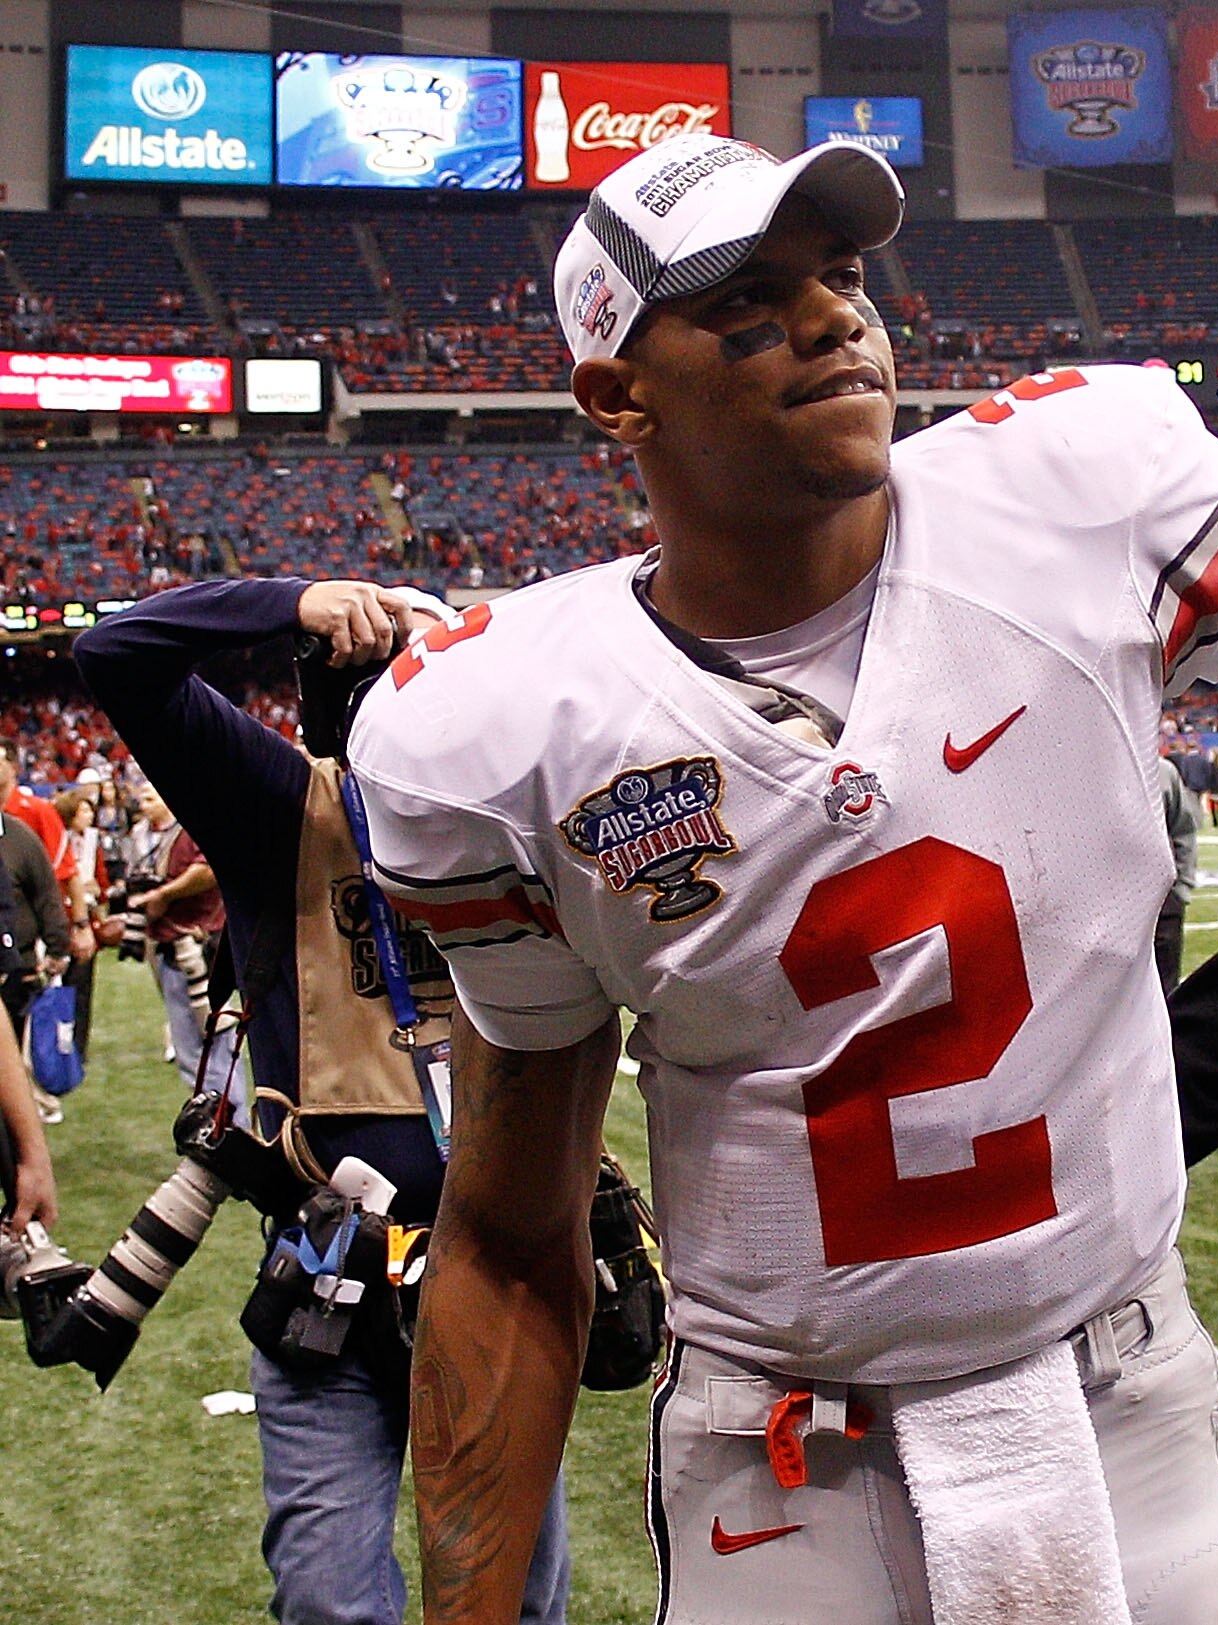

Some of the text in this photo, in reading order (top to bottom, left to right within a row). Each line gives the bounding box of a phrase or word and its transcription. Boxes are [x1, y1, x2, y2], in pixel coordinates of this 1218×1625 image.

[1051, 62, 1125, 80] Allstate
[635, 161, 679, 202] Allstate
[641, 184, 665, 208] 2011
[663, 155, 703, 184] SUGAR
[1176, 361, 1203, 384] 31
[777, 835, 1059, 1268] 2
